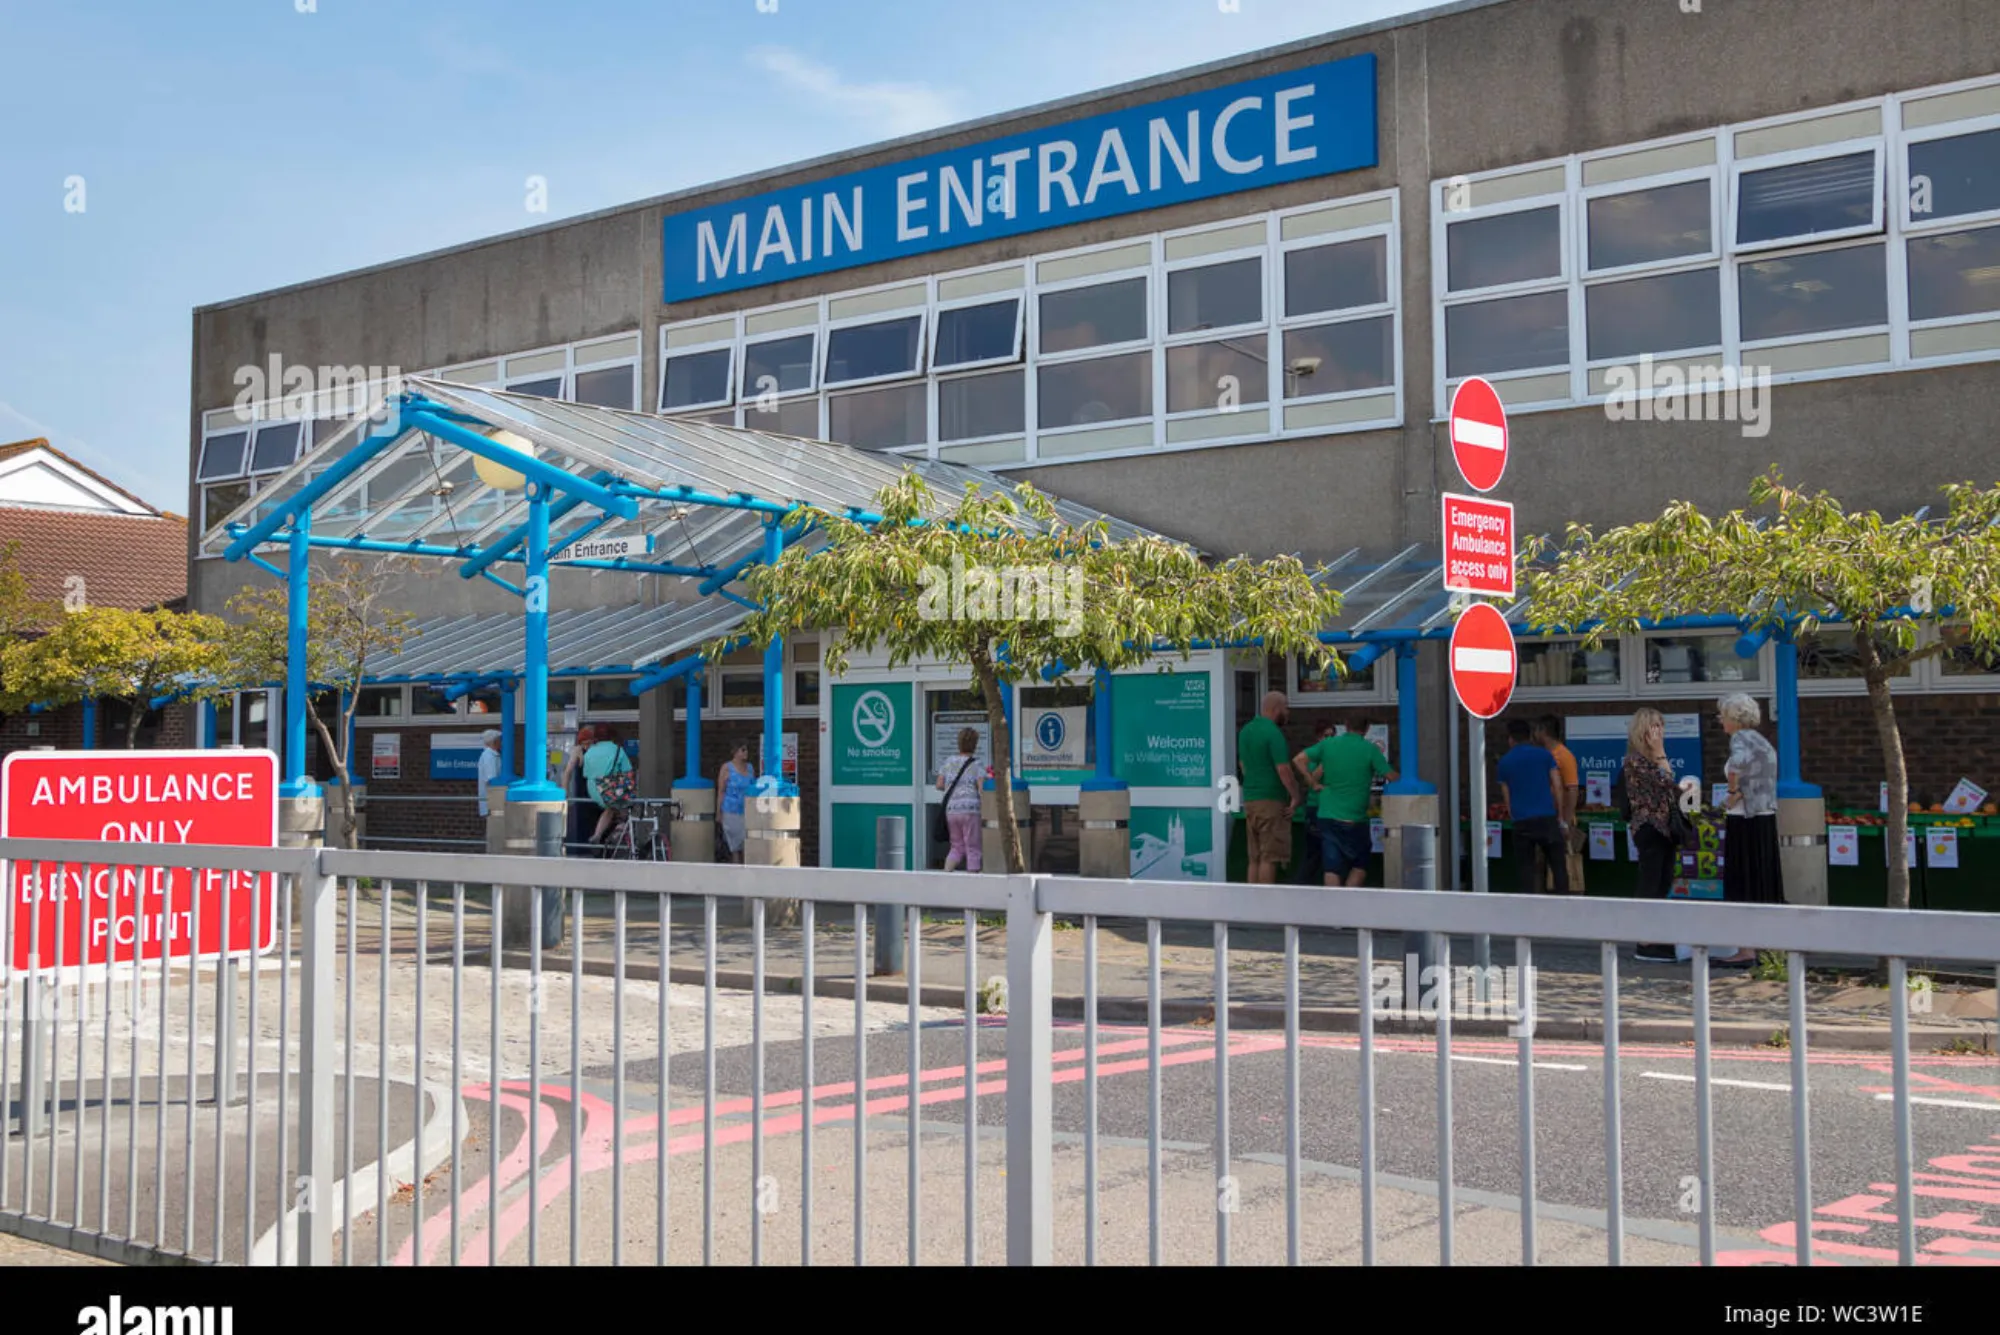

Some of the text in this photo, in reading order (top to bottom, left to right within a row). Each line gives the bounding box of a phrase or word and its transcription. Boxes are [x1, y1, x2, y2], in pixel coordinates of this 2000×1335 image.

[696, 83, 1318, 283] MAIN ENTRANCE
[1451, 506, 1505, 536] Emergency
[575, 541, 629, 557] Entrance
[1452, 531, 1506, 556] Ambulance
[1450, 560, 1508, 585] access only
[847, 746, 901, 760] No smoking
[1147, 735, 1205, 749] Welcome
[1581, 756, 1616, 769] Main
[31, 773, 254, 806] AMBULANCE
